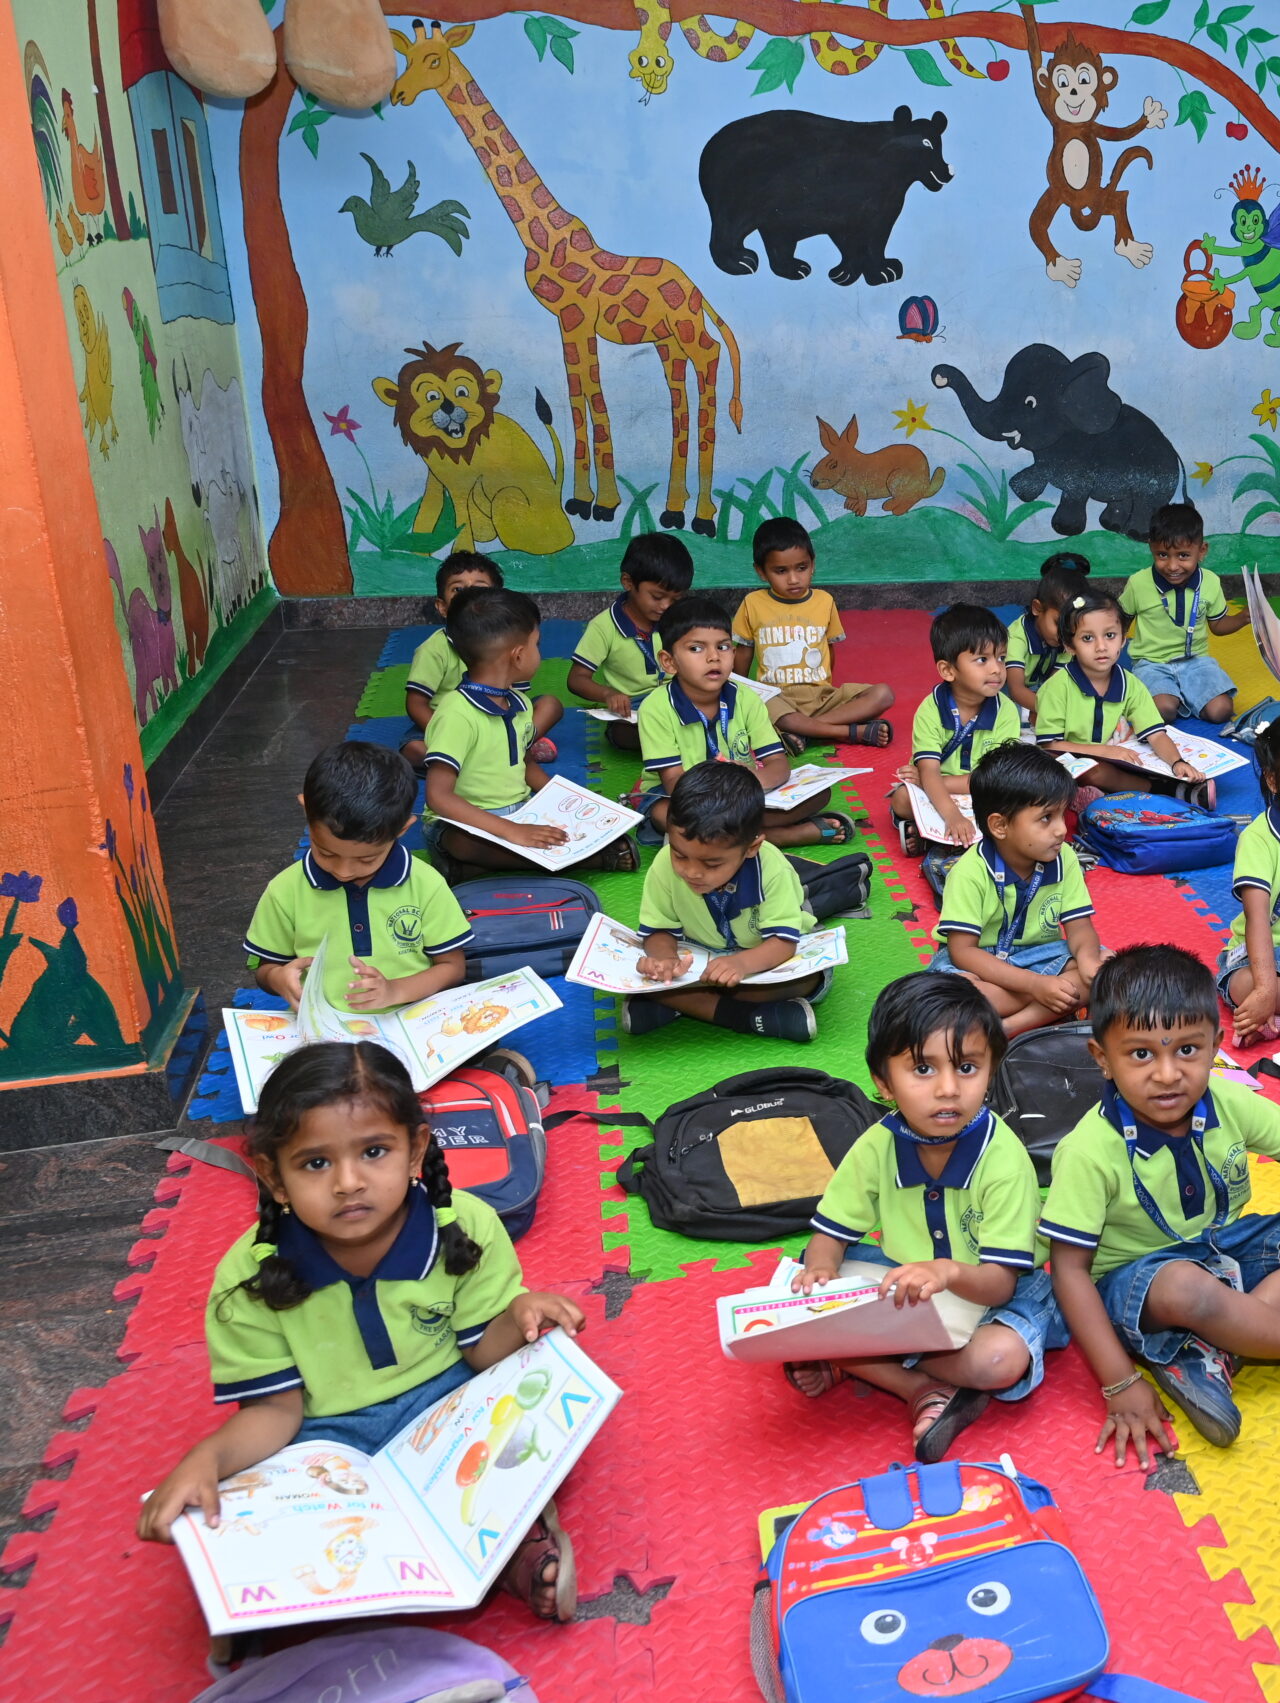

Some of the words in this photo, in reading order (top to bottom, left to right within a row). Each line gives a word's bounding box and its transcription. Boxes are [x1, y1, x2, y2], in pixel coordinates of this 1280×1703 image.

[744, 1099, 784, 1114] GLOBUS
[1222, 1146, 1241, 1179] NATIONAL
[424, 1427, 472, 1491] Vegetables
[292, 1503, 342, 1512] Watch
